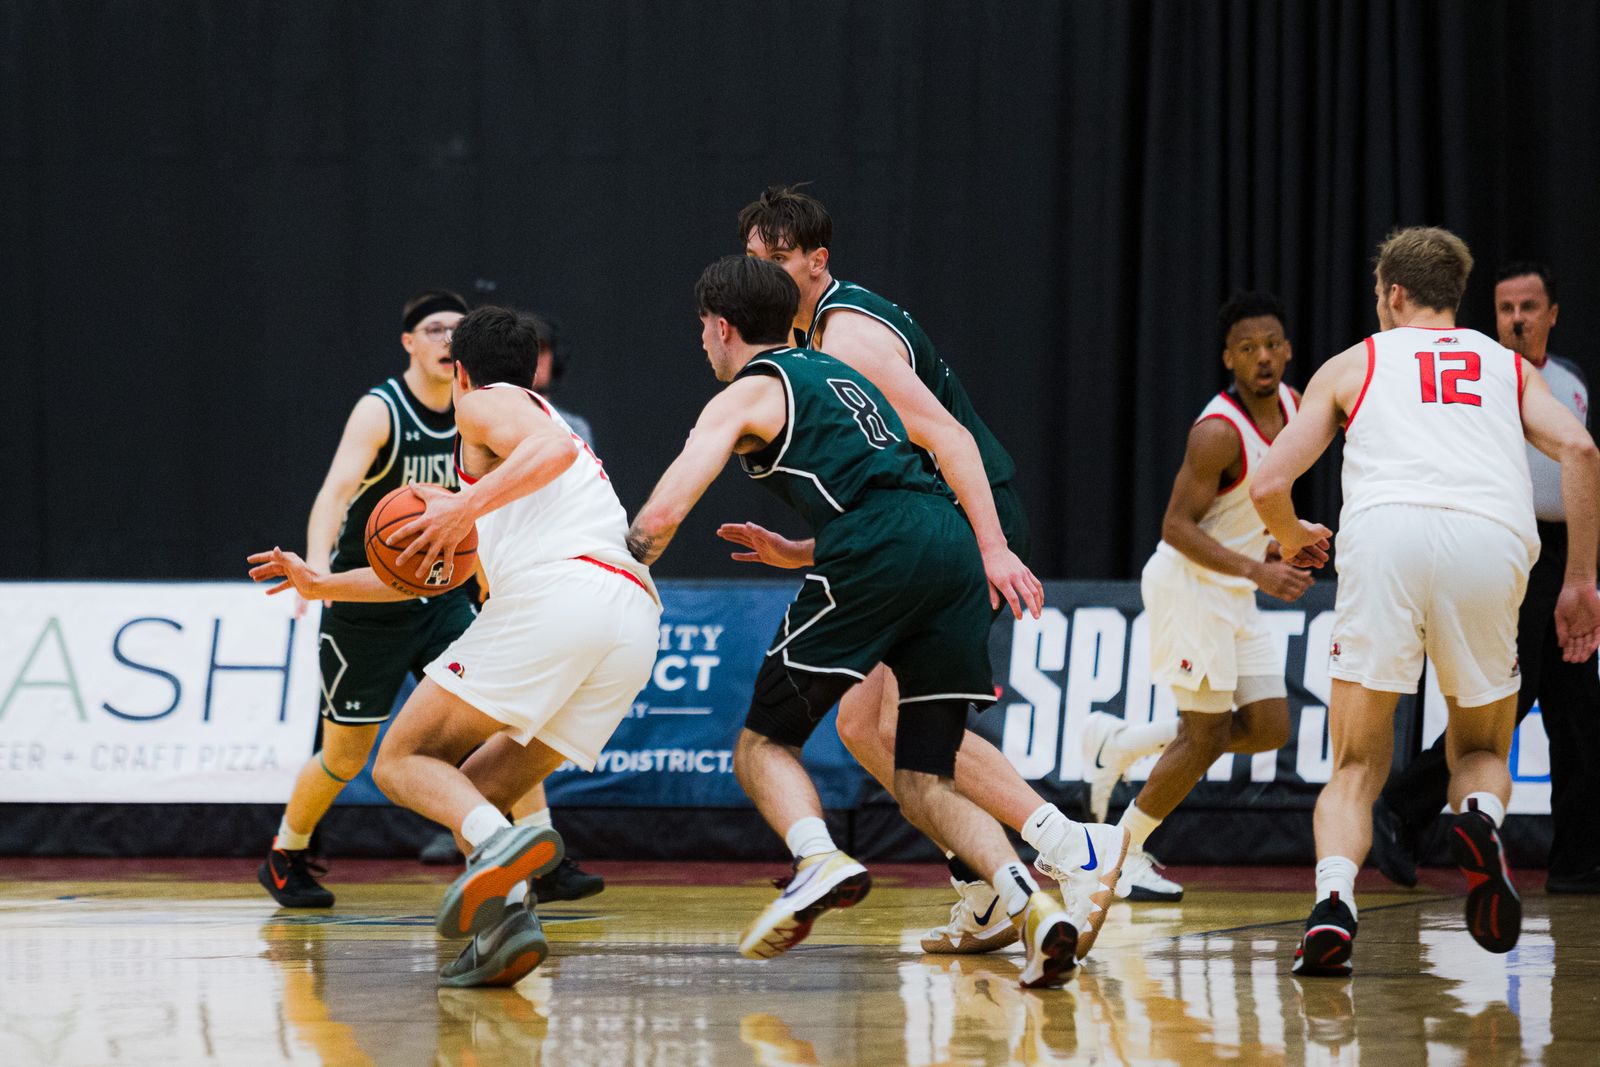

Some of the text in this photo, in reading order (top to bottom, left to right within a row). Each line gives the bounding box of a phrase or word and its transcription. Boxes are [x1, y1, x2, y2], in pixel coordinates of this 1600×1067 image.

[1414, 351, 1482, 407] 12
[826, 378, 902, 450] 8
[400, 453, 460, 488] HUSK
[0, 617, 298, 722] ASH
[90, 741, 187, 771] CRAFT
[198, 742, 280, 772] PIZZA
